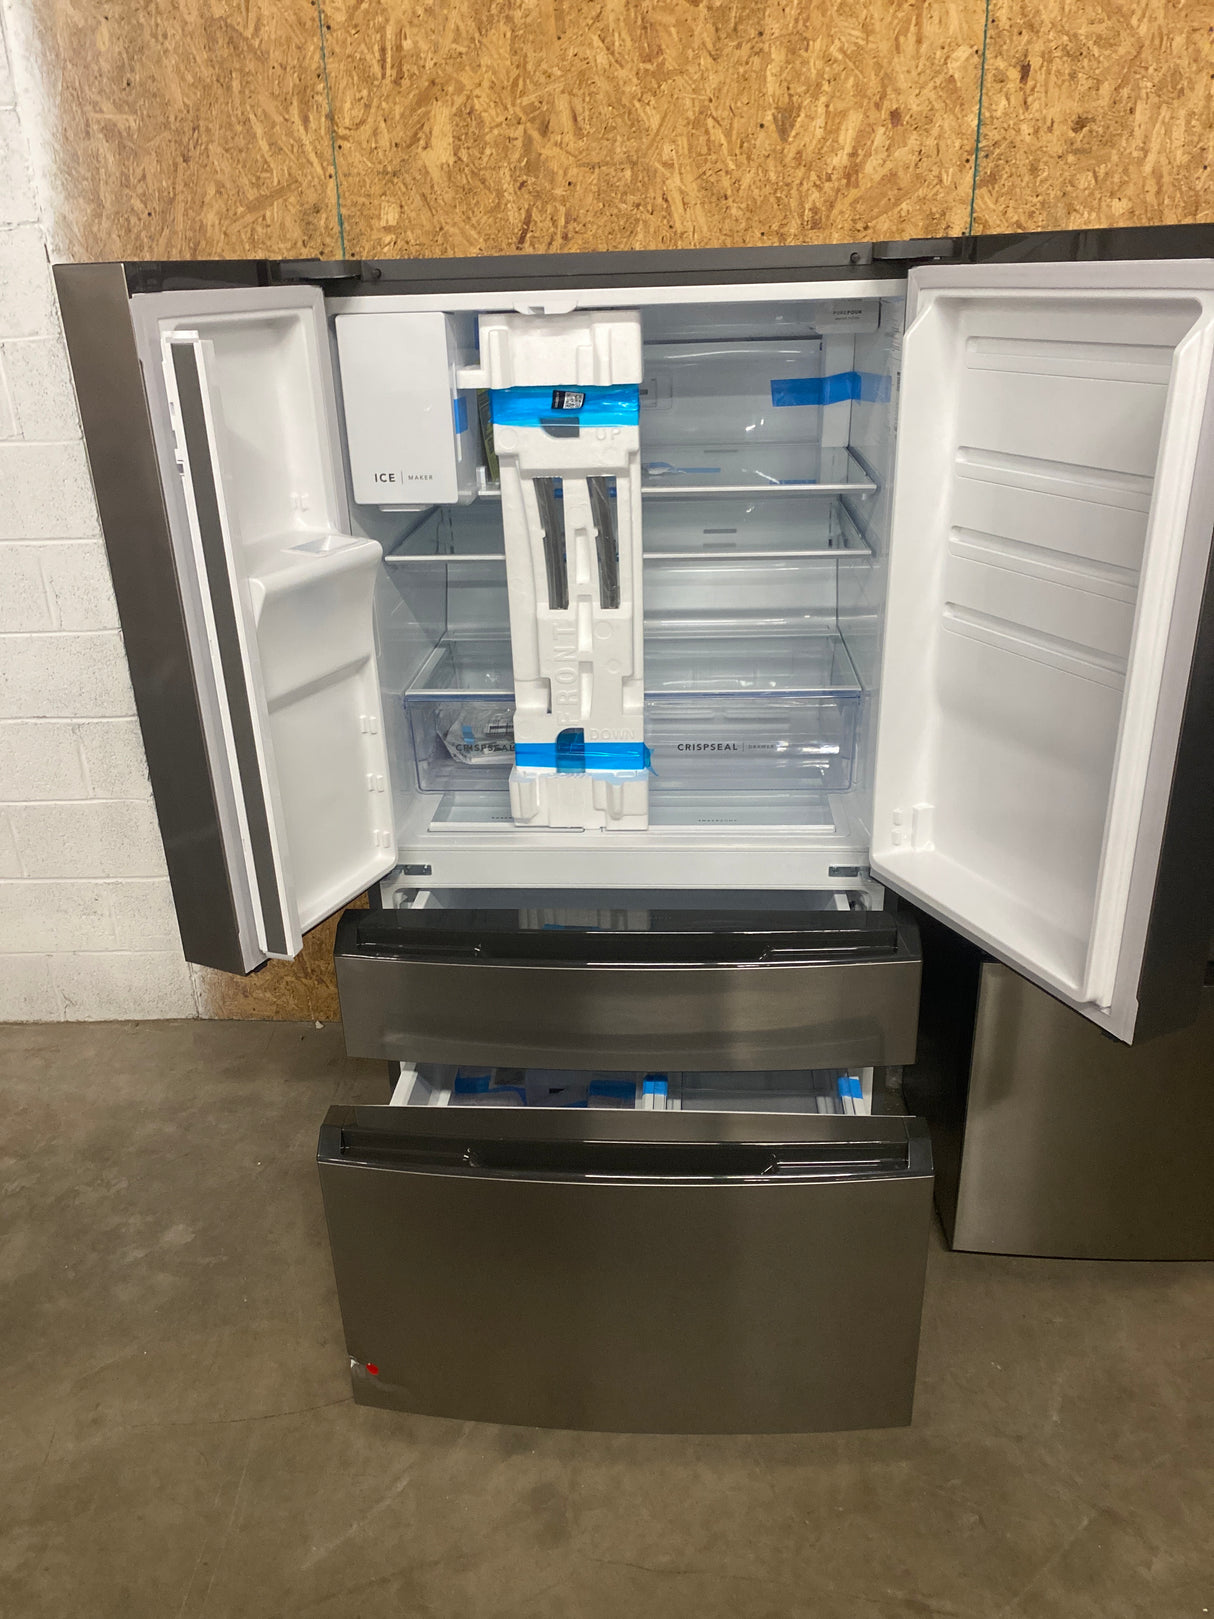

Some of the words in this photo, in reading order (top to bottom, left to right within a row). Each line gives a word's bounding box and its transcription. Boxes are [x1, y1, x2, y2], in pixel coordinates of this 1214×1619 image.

[374, 473, 396, 483] ICE
[553, 622, 579, 727] FRONT
[590, 727, 636, 741] DOWN
[677, 743, 738, 751] CRISPSEAL
